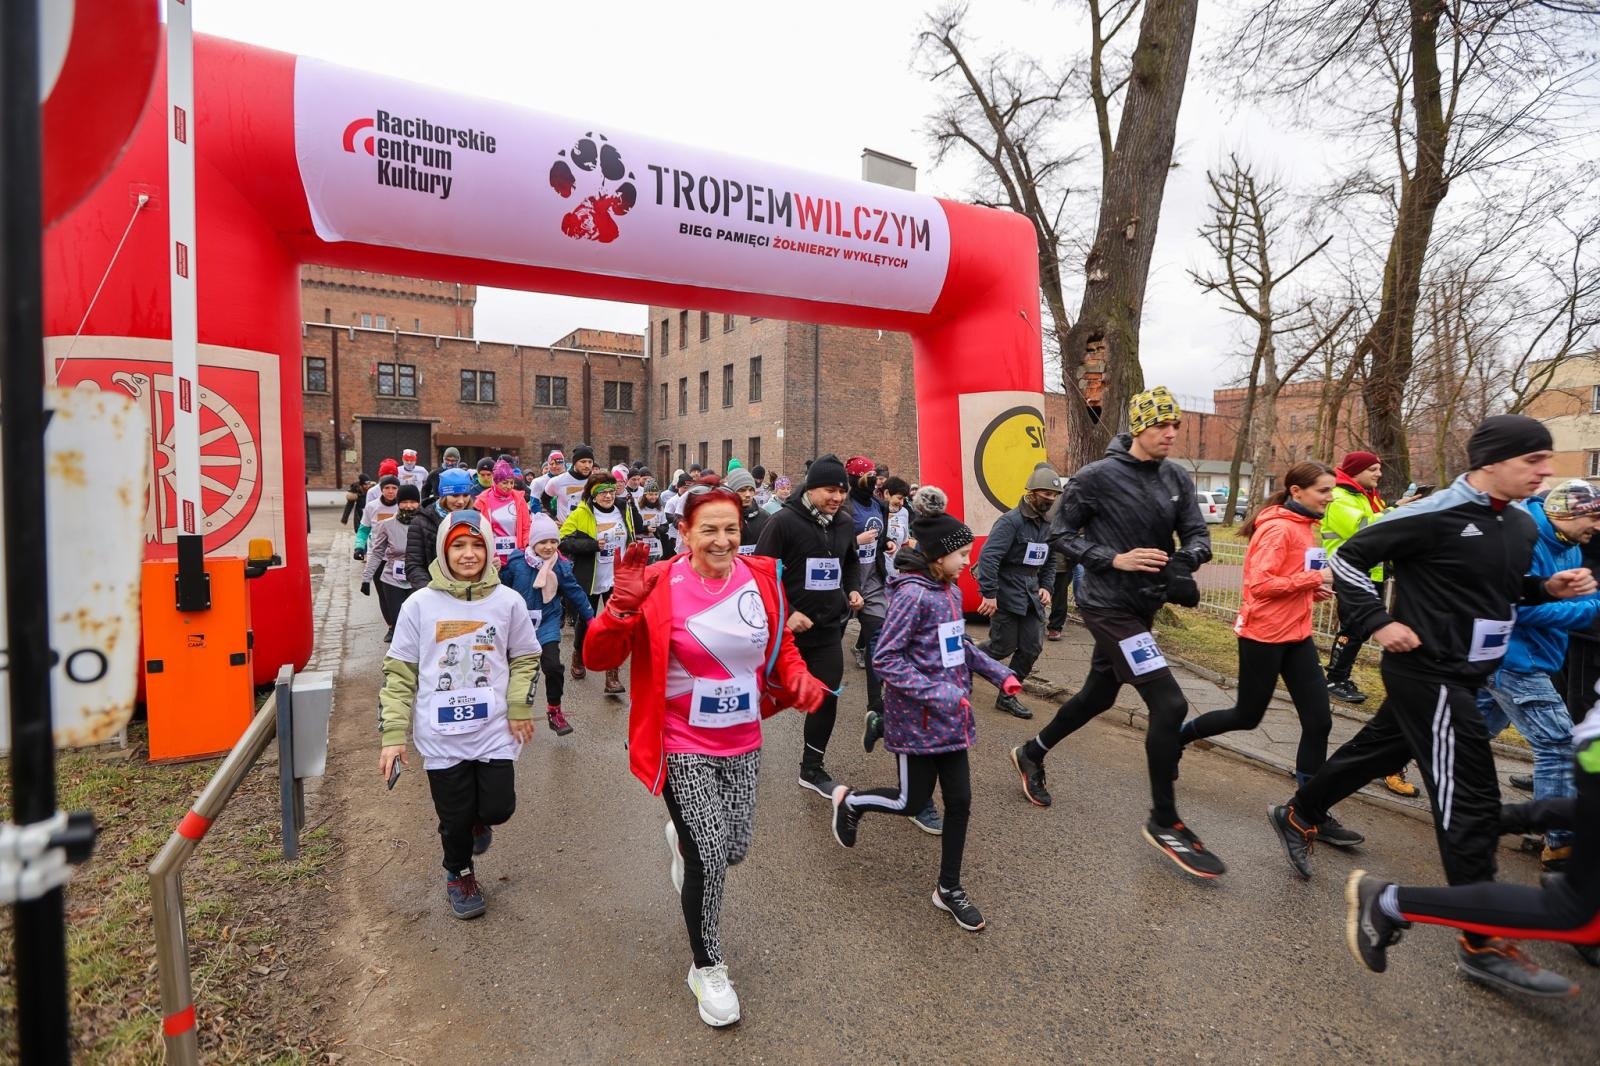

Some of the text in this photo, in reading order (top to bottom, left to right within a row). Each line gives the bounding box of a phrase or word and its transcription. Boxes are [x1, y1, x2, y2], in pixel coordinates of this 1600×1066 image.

[377, 109, 497, 154] Raciborskie
[377, 160, 453, 199] Kultury
[679, 222, 908, 269] BIEG PAMIĘCI ŻOŁNIERZY WYKLĘTYCH
[824, 569, 831, 580] 2
[1143, 643, 1161, 659] 31
[453, 705, 475, 721] 83
[716, 696, 740, 713] 59
